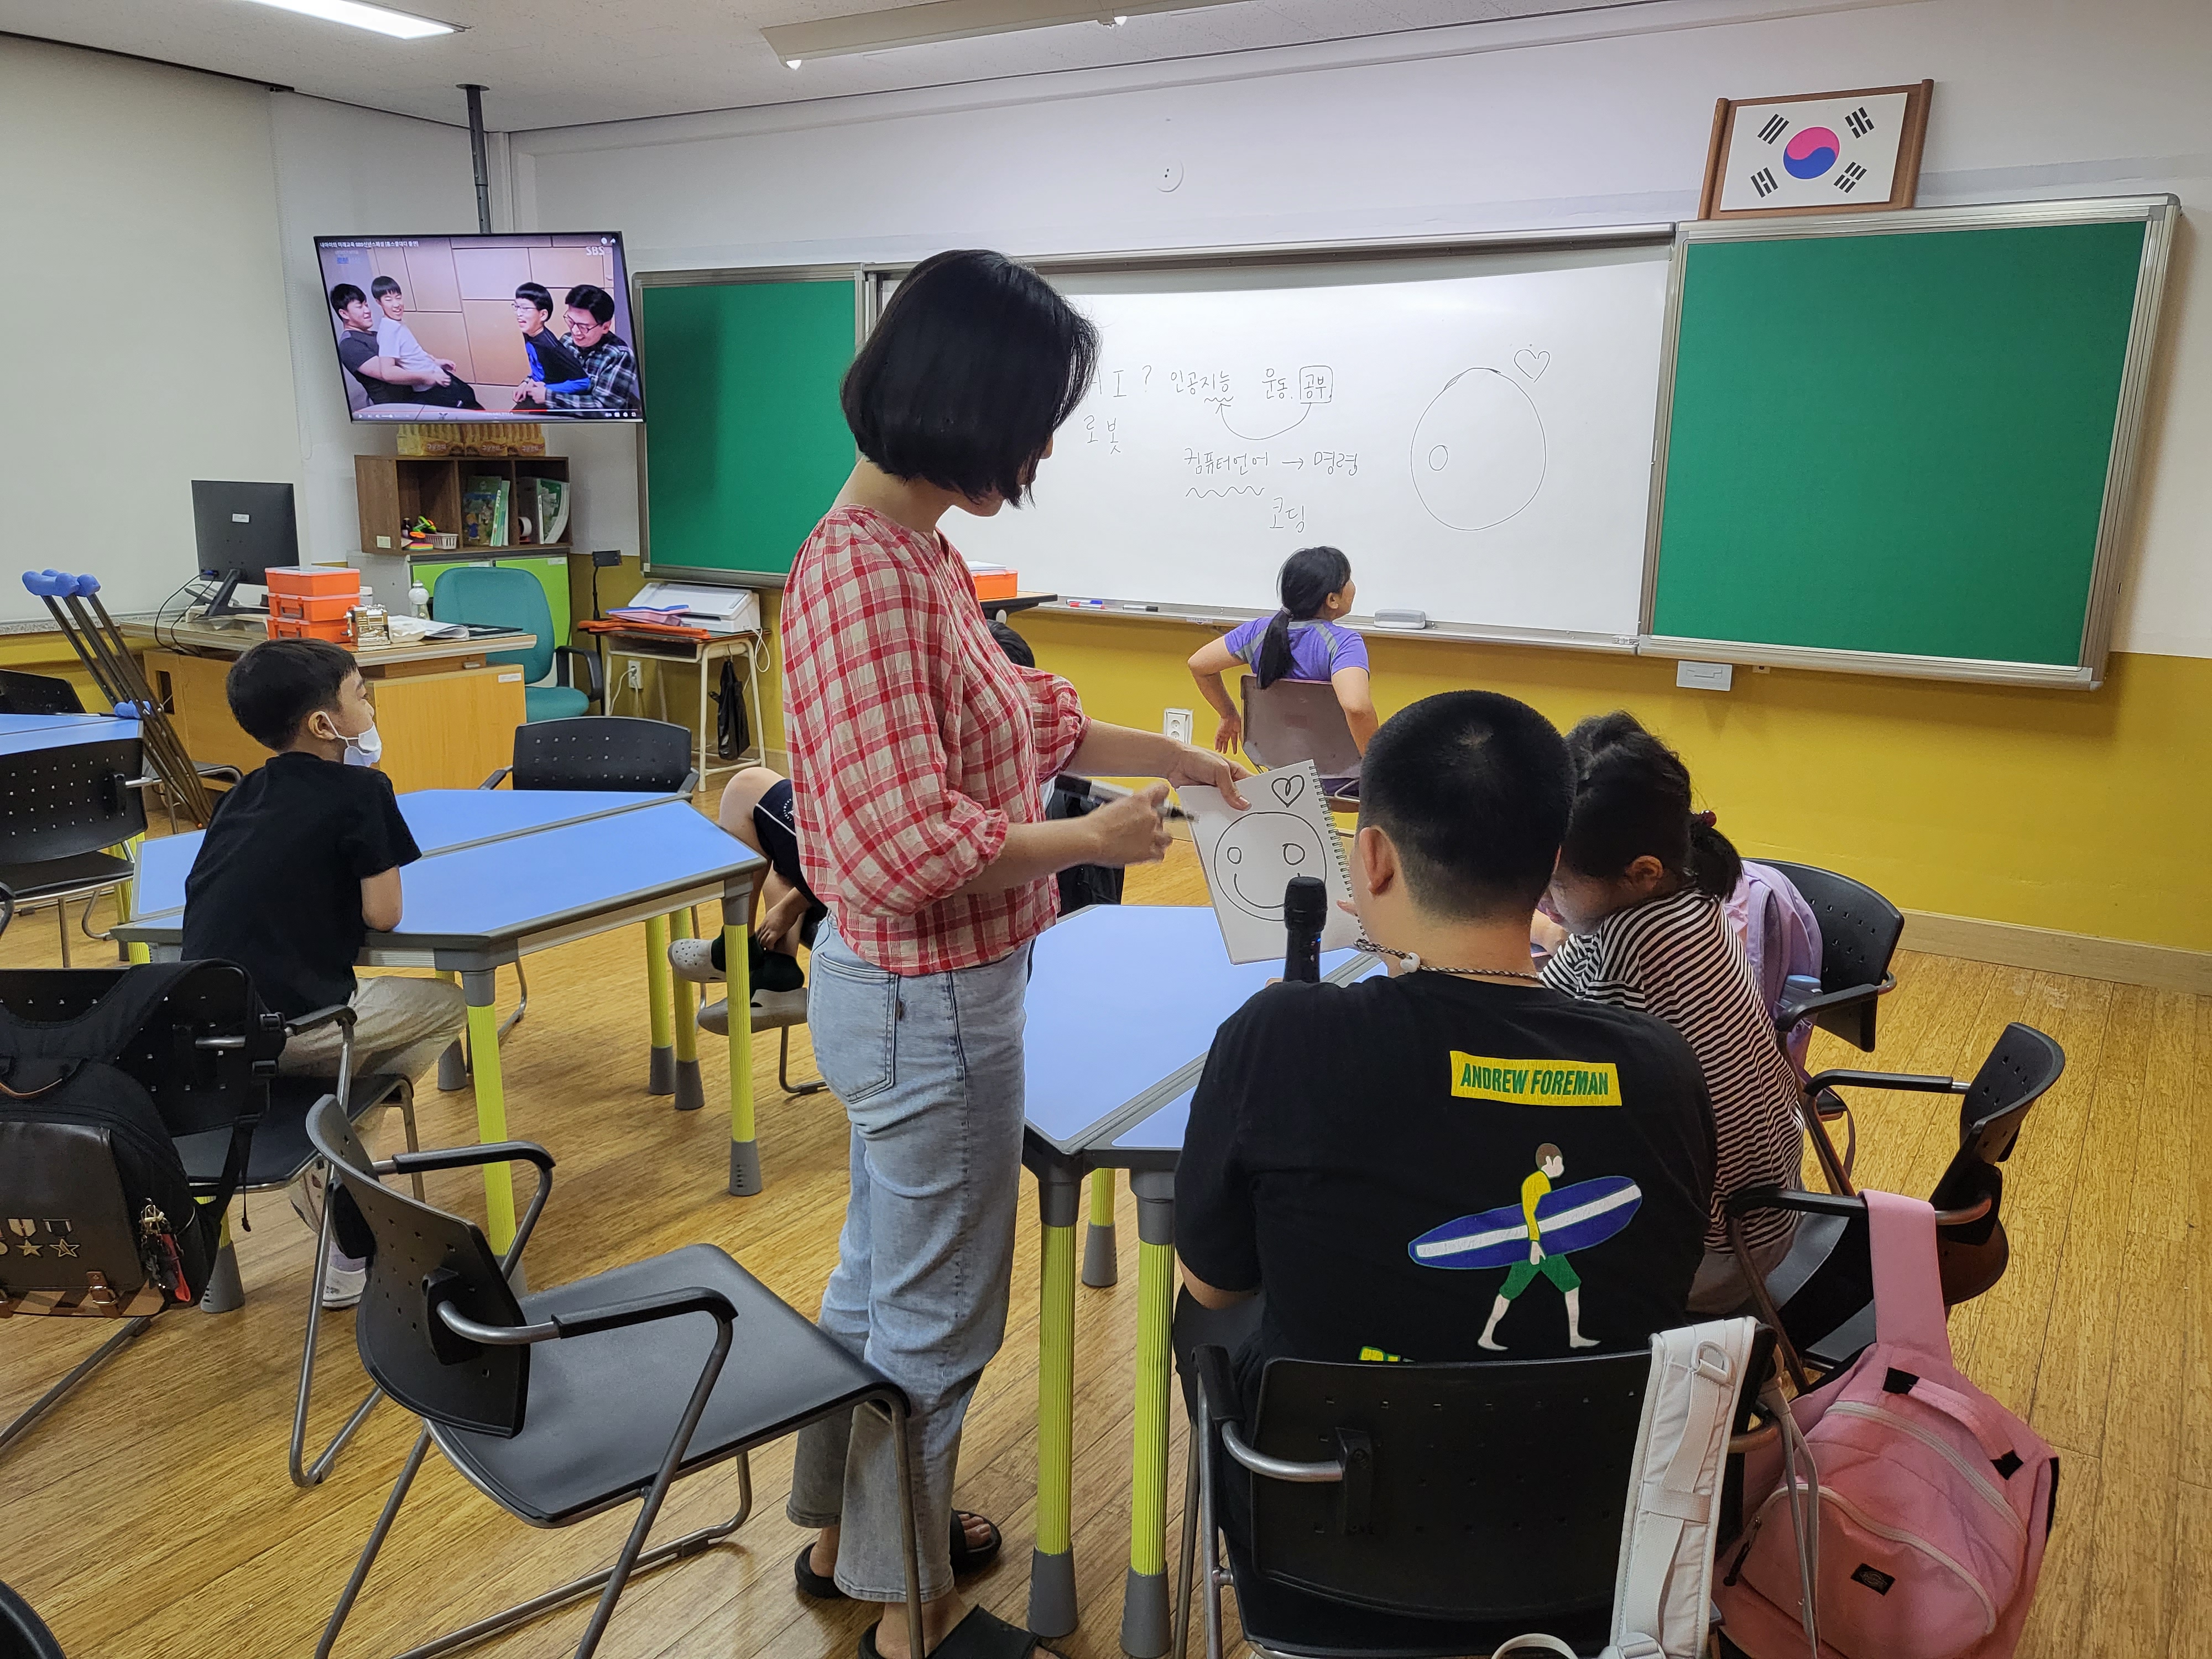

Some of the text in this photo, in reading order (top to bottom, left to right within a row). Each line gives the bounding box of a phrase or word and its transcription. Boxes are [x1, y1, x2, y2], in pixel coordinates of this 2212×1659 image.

[586, 246, 605, 255] SBS
[1171, 370, 1230, 395] 인공지능
[1084, 415, 1121, 455] 로봇
[1314, 451, 1358, 476] 명령
[1269, 497, 1305, 533] 코딩
[1460, 1063, 1608, 1095] ANDREW FOREMAN
